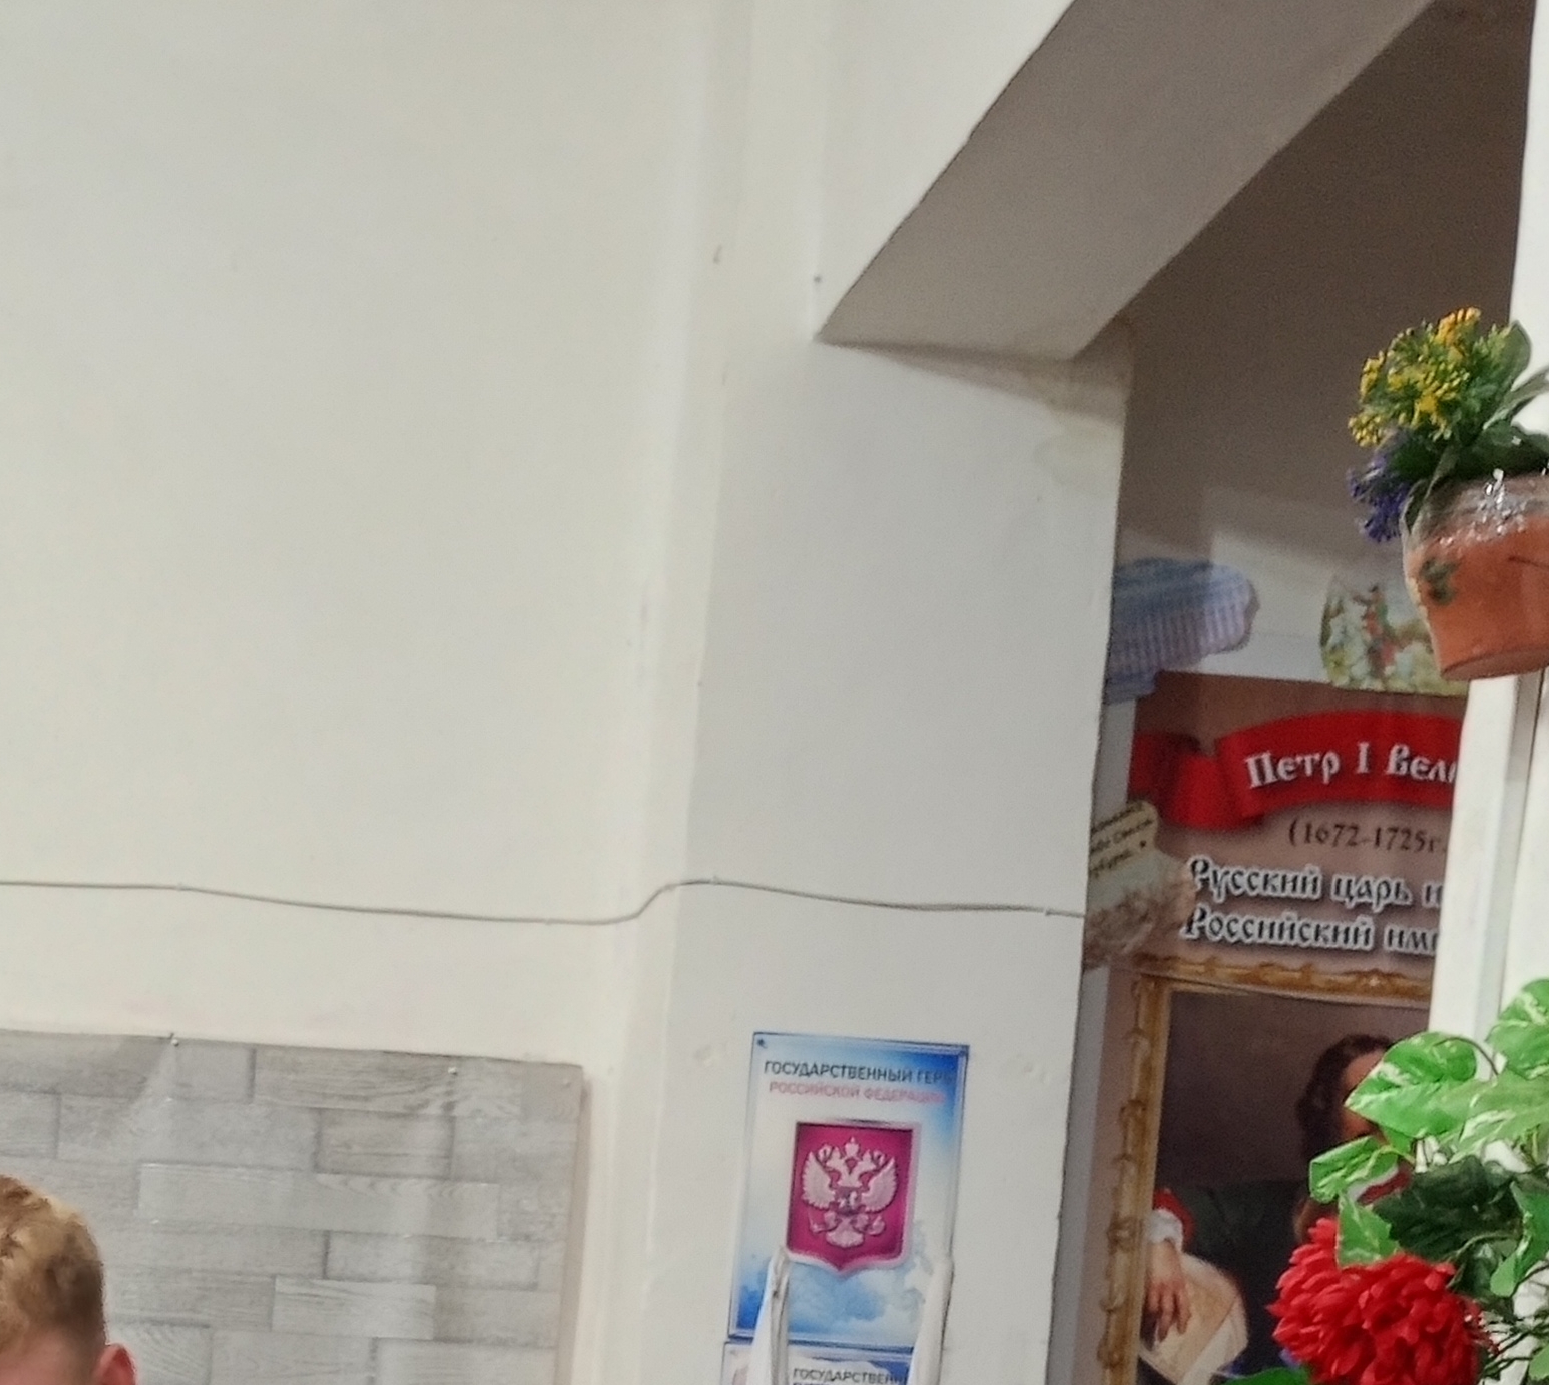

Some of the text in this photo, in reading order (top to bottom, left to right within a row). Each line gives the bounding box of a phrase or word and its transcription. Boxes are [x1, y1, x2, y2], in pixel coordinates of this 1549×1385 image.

[1246, 751, 1340, 788] Петр
[1386, 744, 1455, 783] Вел
[1190, 857, 1319, 897] Русский
[1185, 906, 1372, 948] Российский
[764, 1060, 912, 1083] ГОСУДАРСТВЕННЫЙ
